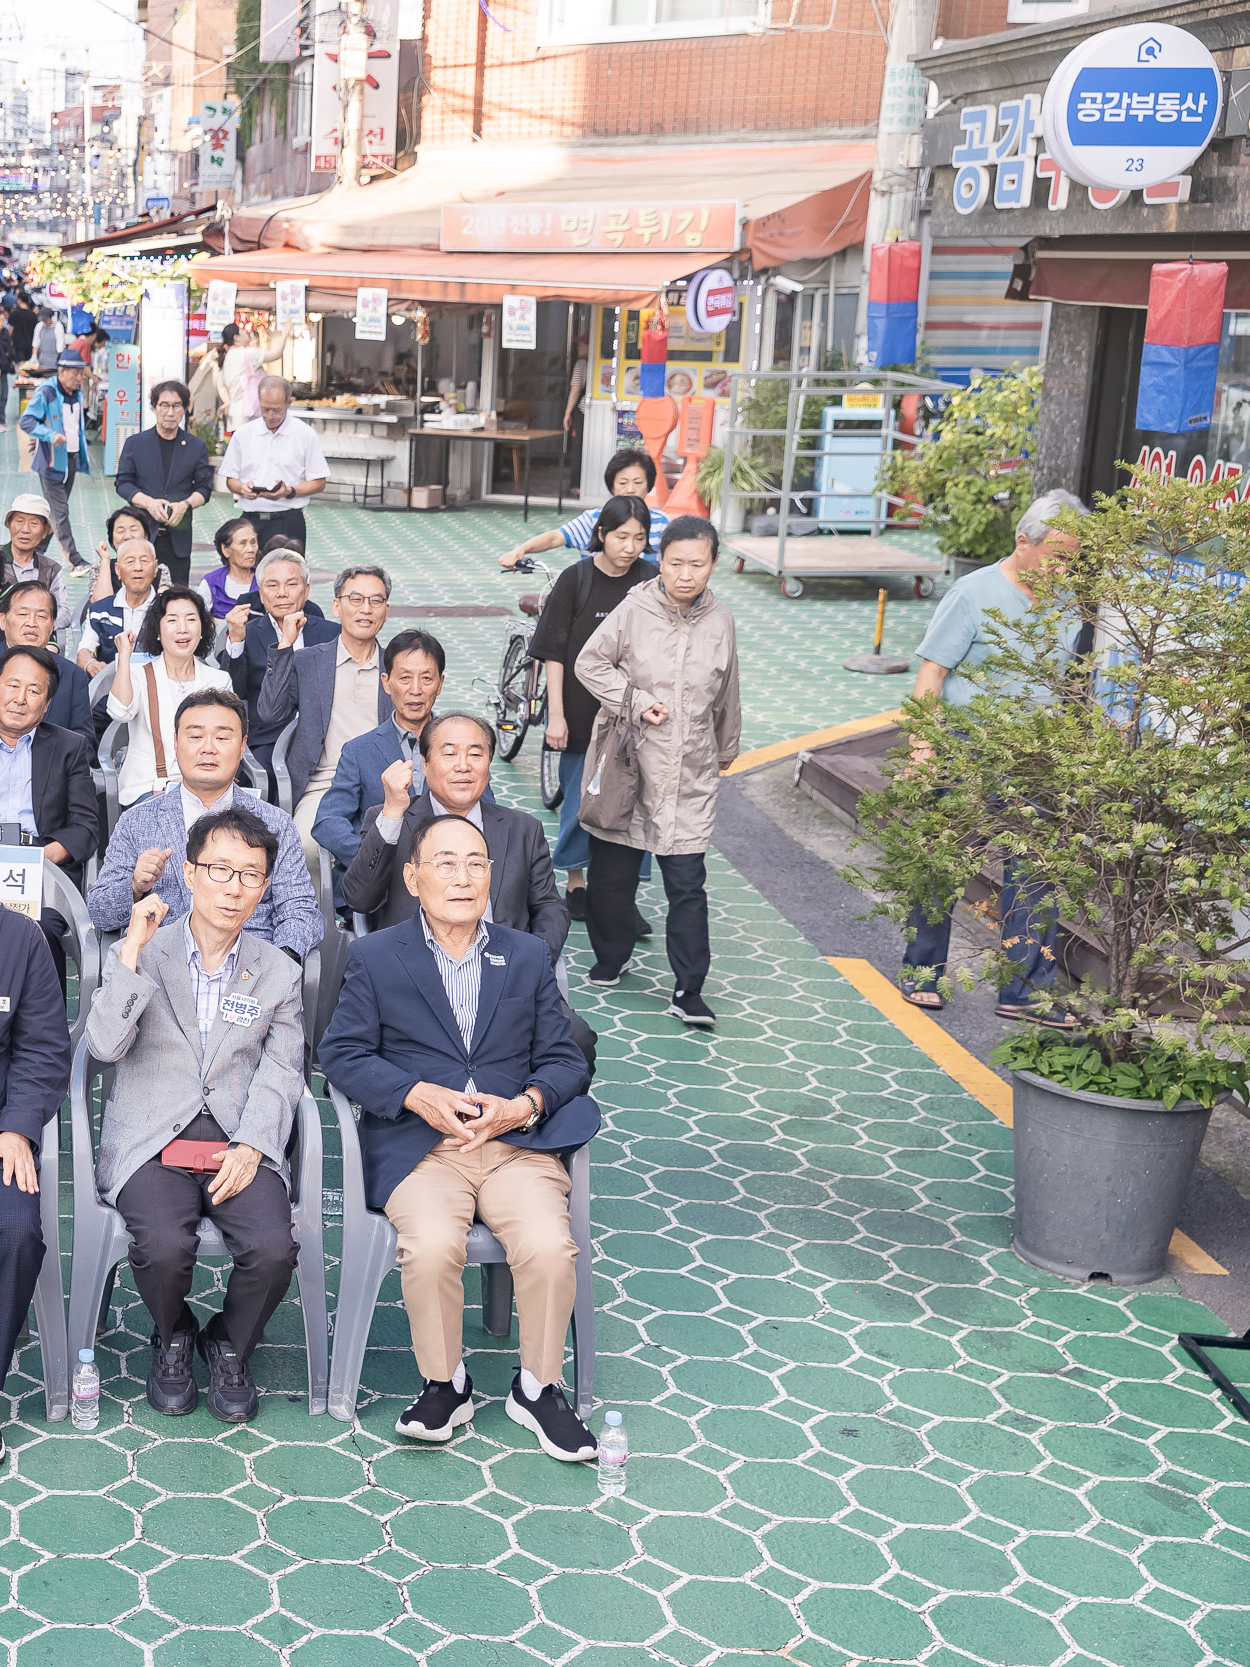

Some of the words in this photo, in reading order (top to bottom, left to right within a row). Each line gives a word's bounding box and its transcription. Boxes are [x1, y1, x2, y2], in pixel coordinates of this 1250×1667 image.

[1076, 90, 1208, 124] 공감부동산
[1124, 157, 1145, 173] 23
[461, 213, 508, 236] 20년
[560, 207, 712, 248] 면곡튀김
[222, 998, 260, 1017] 전병주
